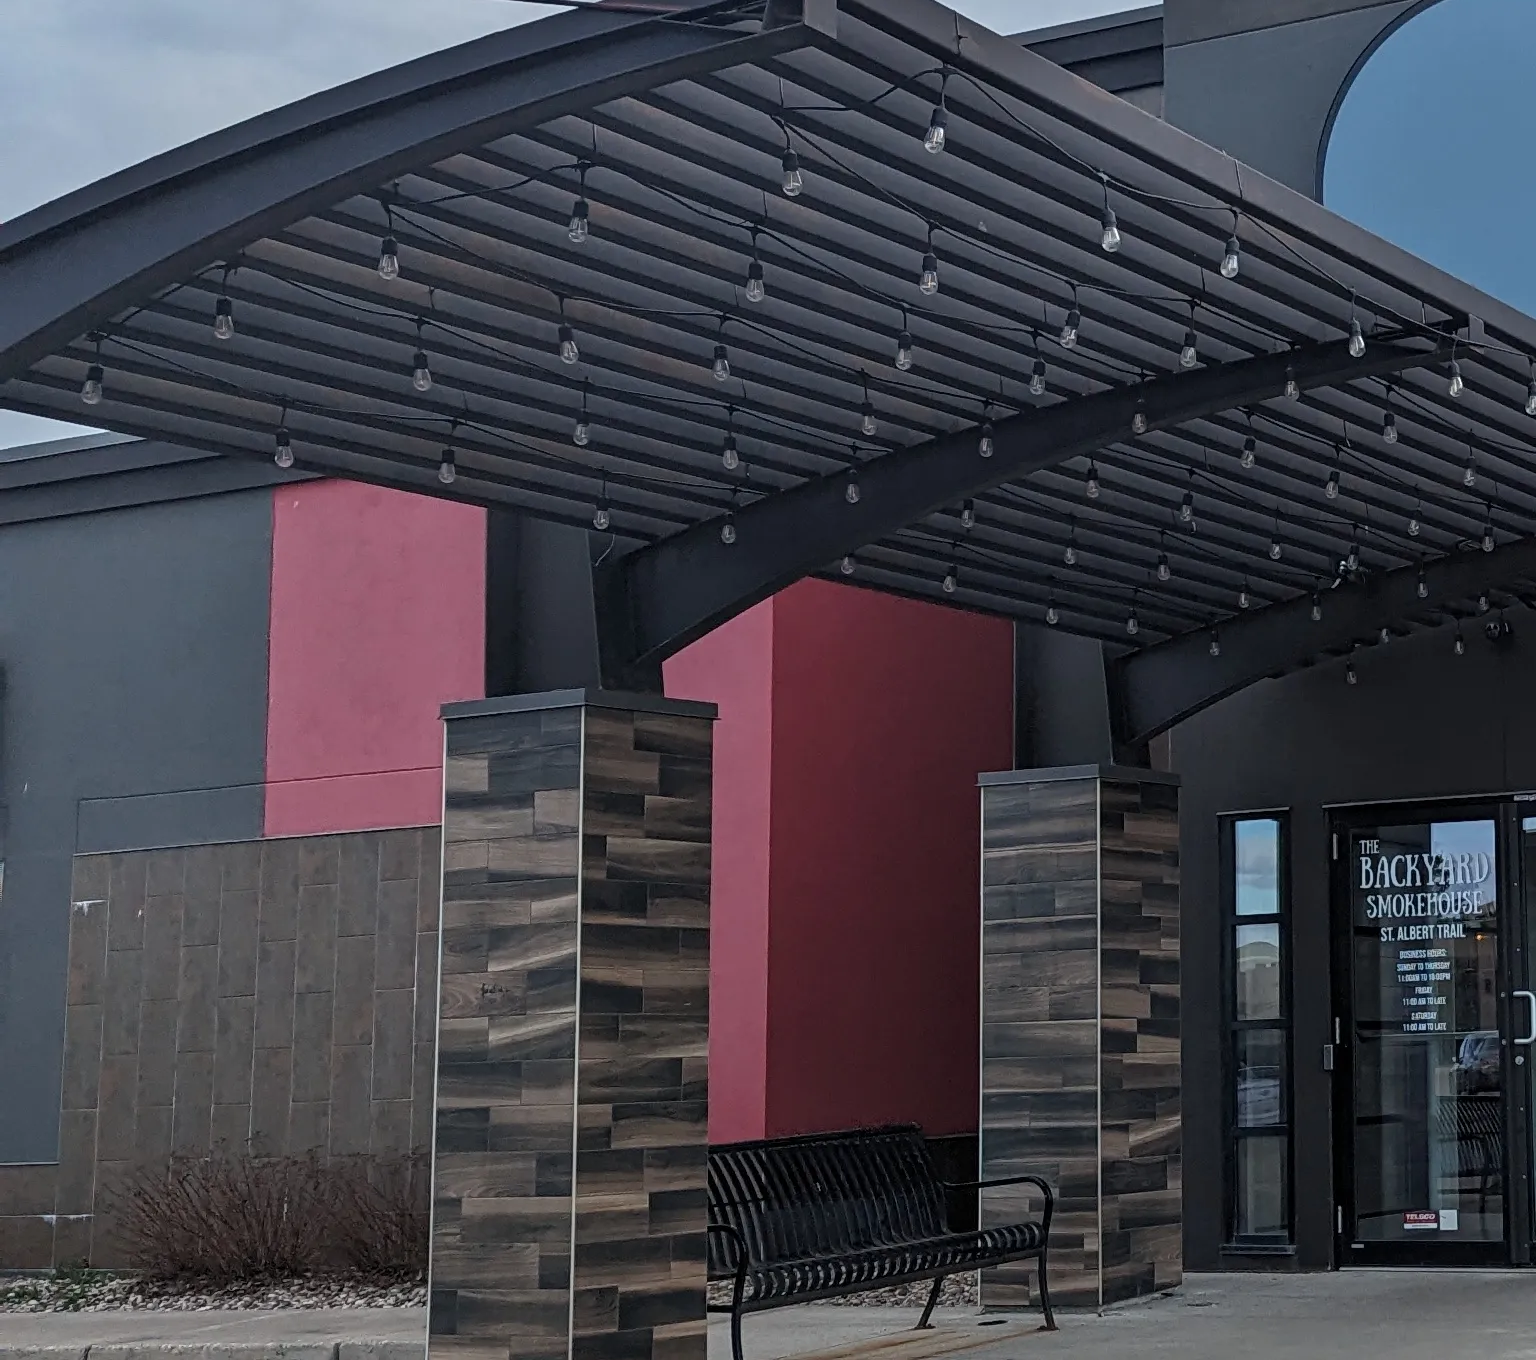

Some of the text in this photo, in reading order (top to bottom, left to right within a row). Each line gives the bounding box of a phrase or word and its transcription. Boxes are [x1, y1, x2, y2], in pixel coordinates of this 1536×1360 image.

[1359, 839, 1380, 855] THE
[1359, 851, 1490, 889] BACKYARD
[1366, 890, 1483, 918] SMOKEHOUSE
[1380, 923, 1466, 942] ST. ALBERT TRAIL
[1434, 996, 1447, 1005] LATE
[1434, 1022, 1447, 1031] LATE
